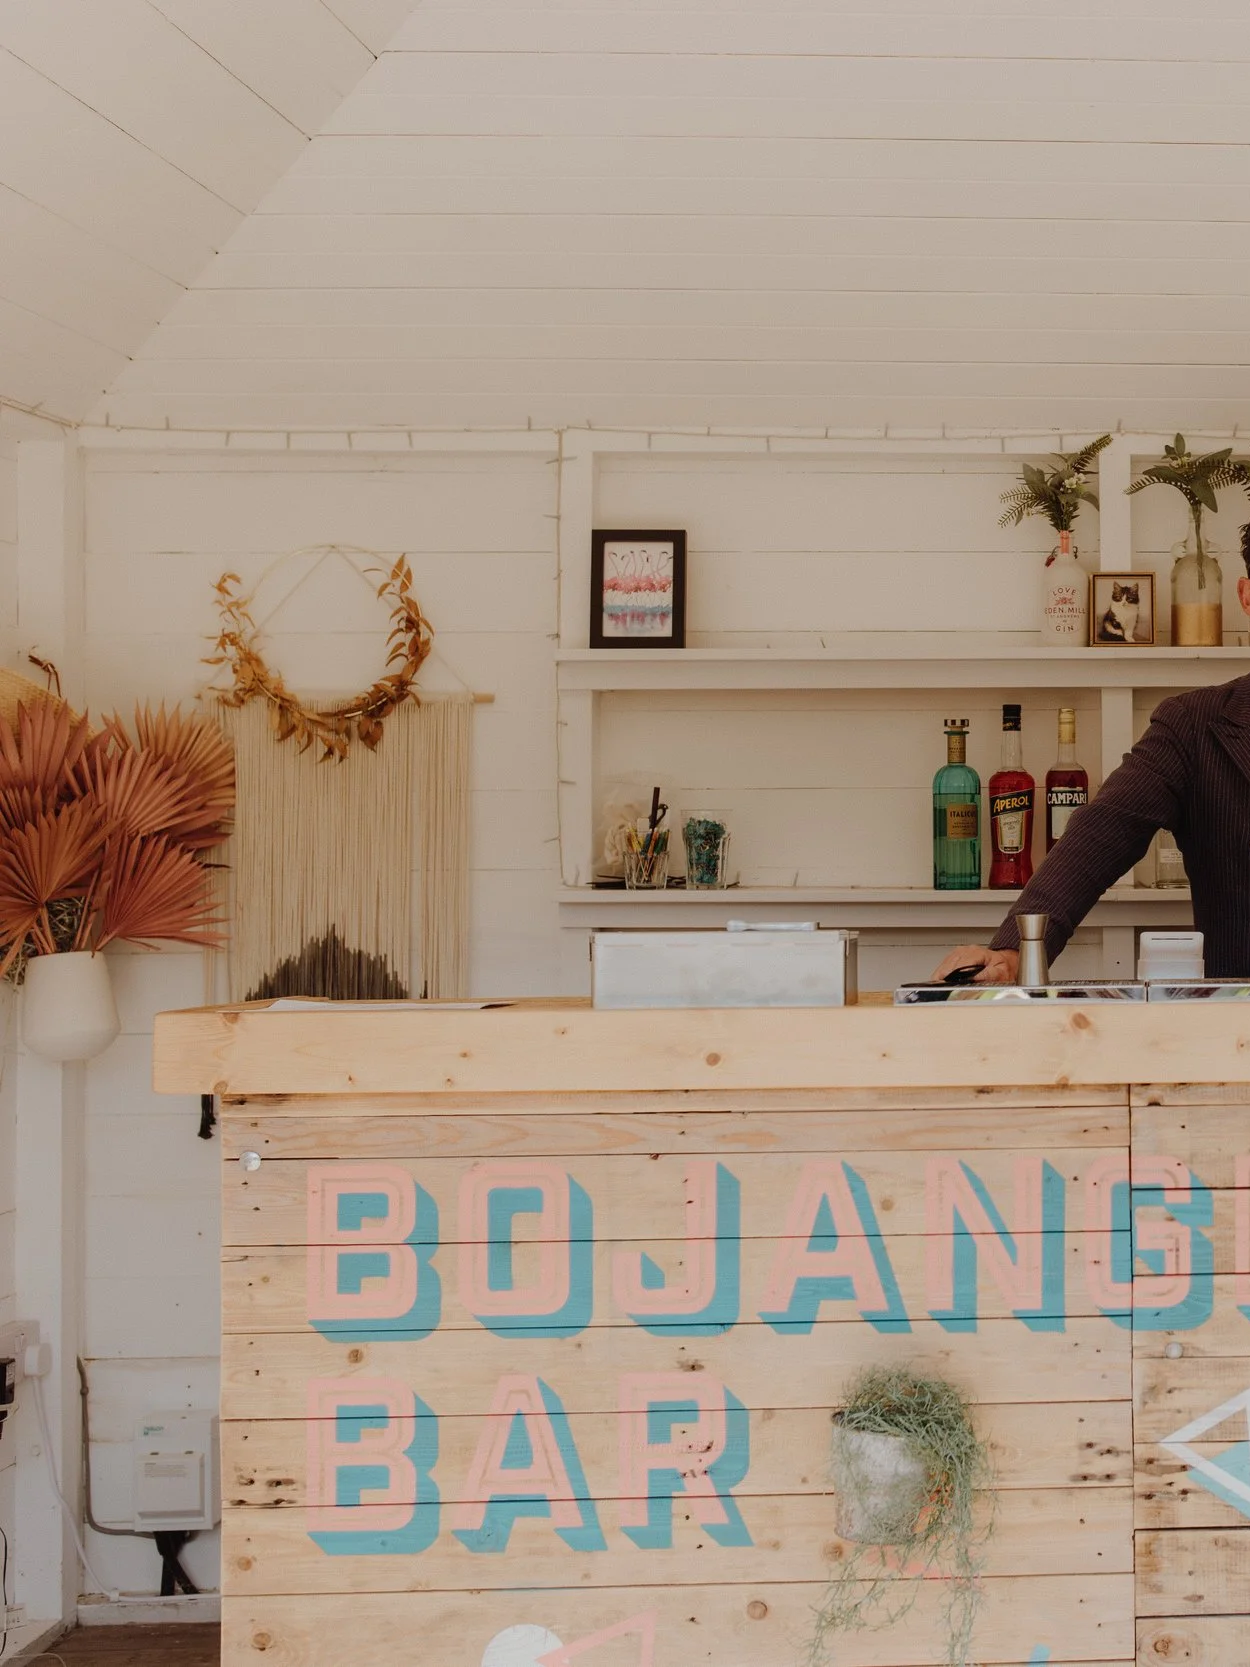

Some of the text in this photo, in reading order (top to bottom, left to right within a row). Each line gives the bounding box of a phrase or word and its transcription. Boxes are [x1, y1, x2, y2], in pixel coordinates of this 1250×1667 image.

[1052, 587, 1077, 597] LOVE
[993, 796, 1030, 813] APEROL
[1047, 792, 1087, 805] CAMPARI
[306, 1371, 755, 1556] BAR
